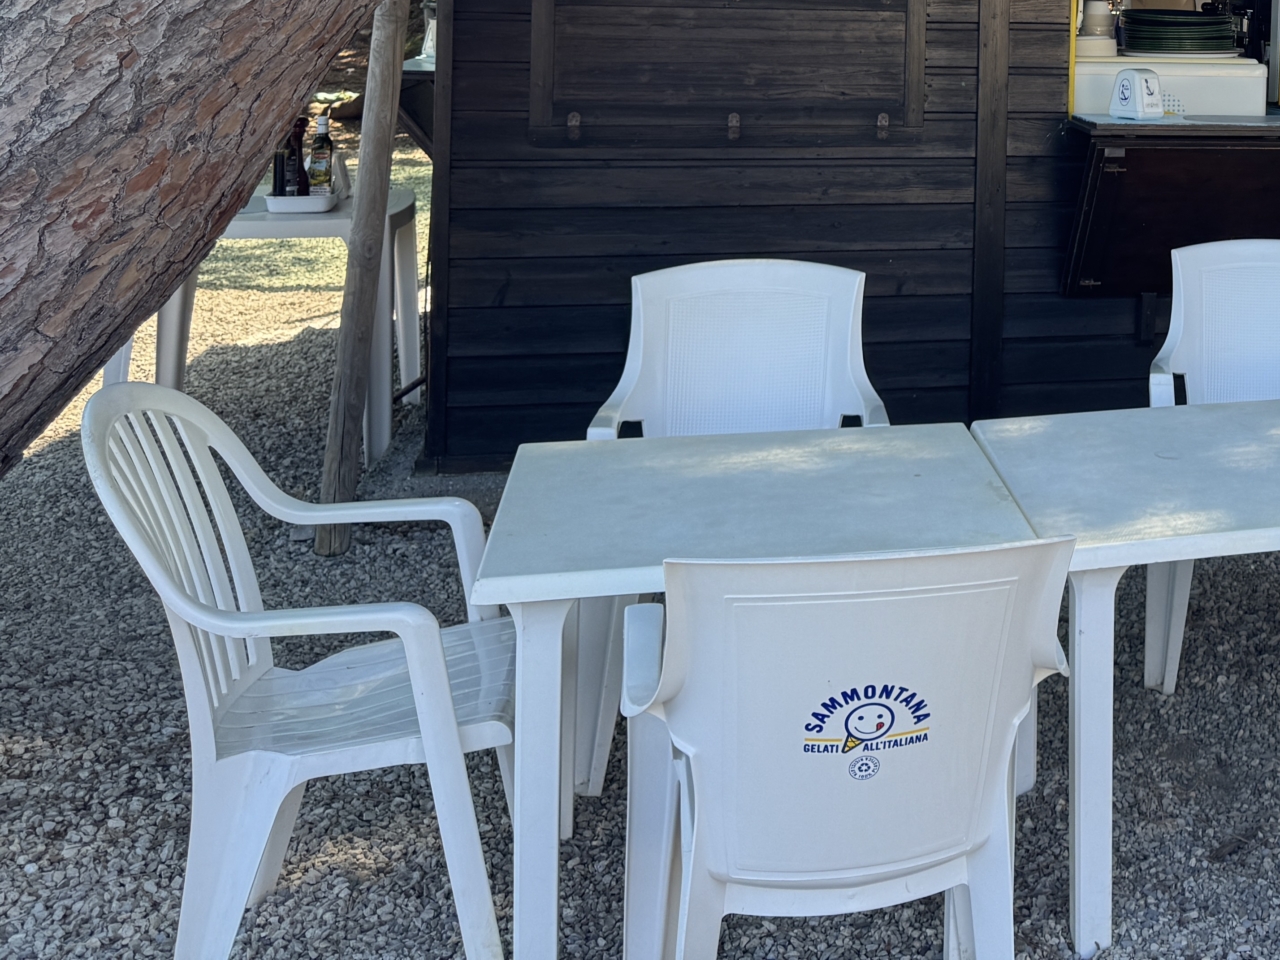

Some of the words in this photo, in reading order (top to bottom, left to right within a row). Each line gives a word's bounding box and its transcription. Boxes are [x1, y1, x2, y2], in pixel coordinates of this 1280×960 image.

[804, 684, 931, 734] SAMMONTANA
[803, 743, 839, 754] GELATI
[862, 732, 929, 752] ALL'ITALIANA
